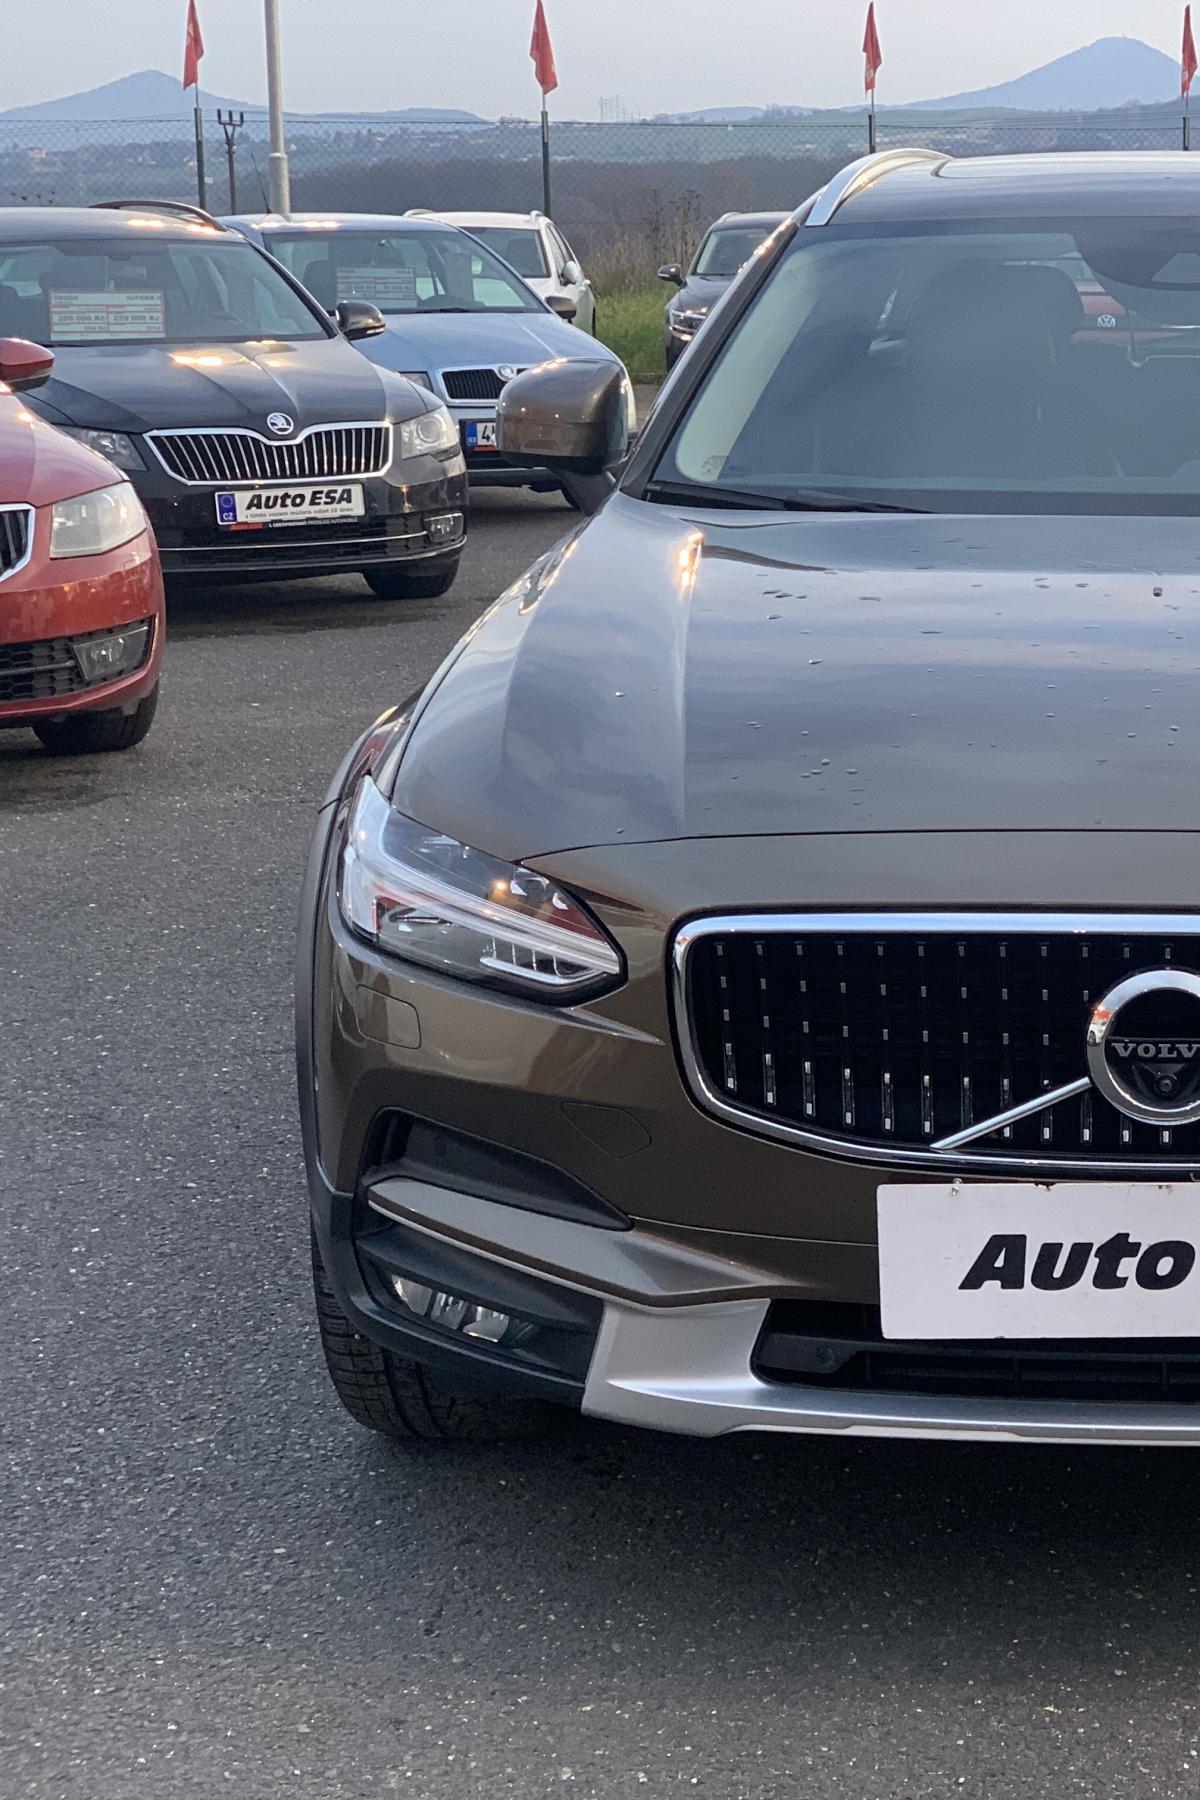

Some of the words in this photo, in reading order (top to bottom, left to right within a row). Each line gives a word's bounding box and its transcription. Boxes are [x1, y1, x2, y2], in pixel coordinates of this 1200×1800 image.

[245, 491, 306, 511] Auto
[308, 488, 353, 506] ESA
[222, 512, 234, 521] CZ
[958, 1232, 1196, 1291] Auto
